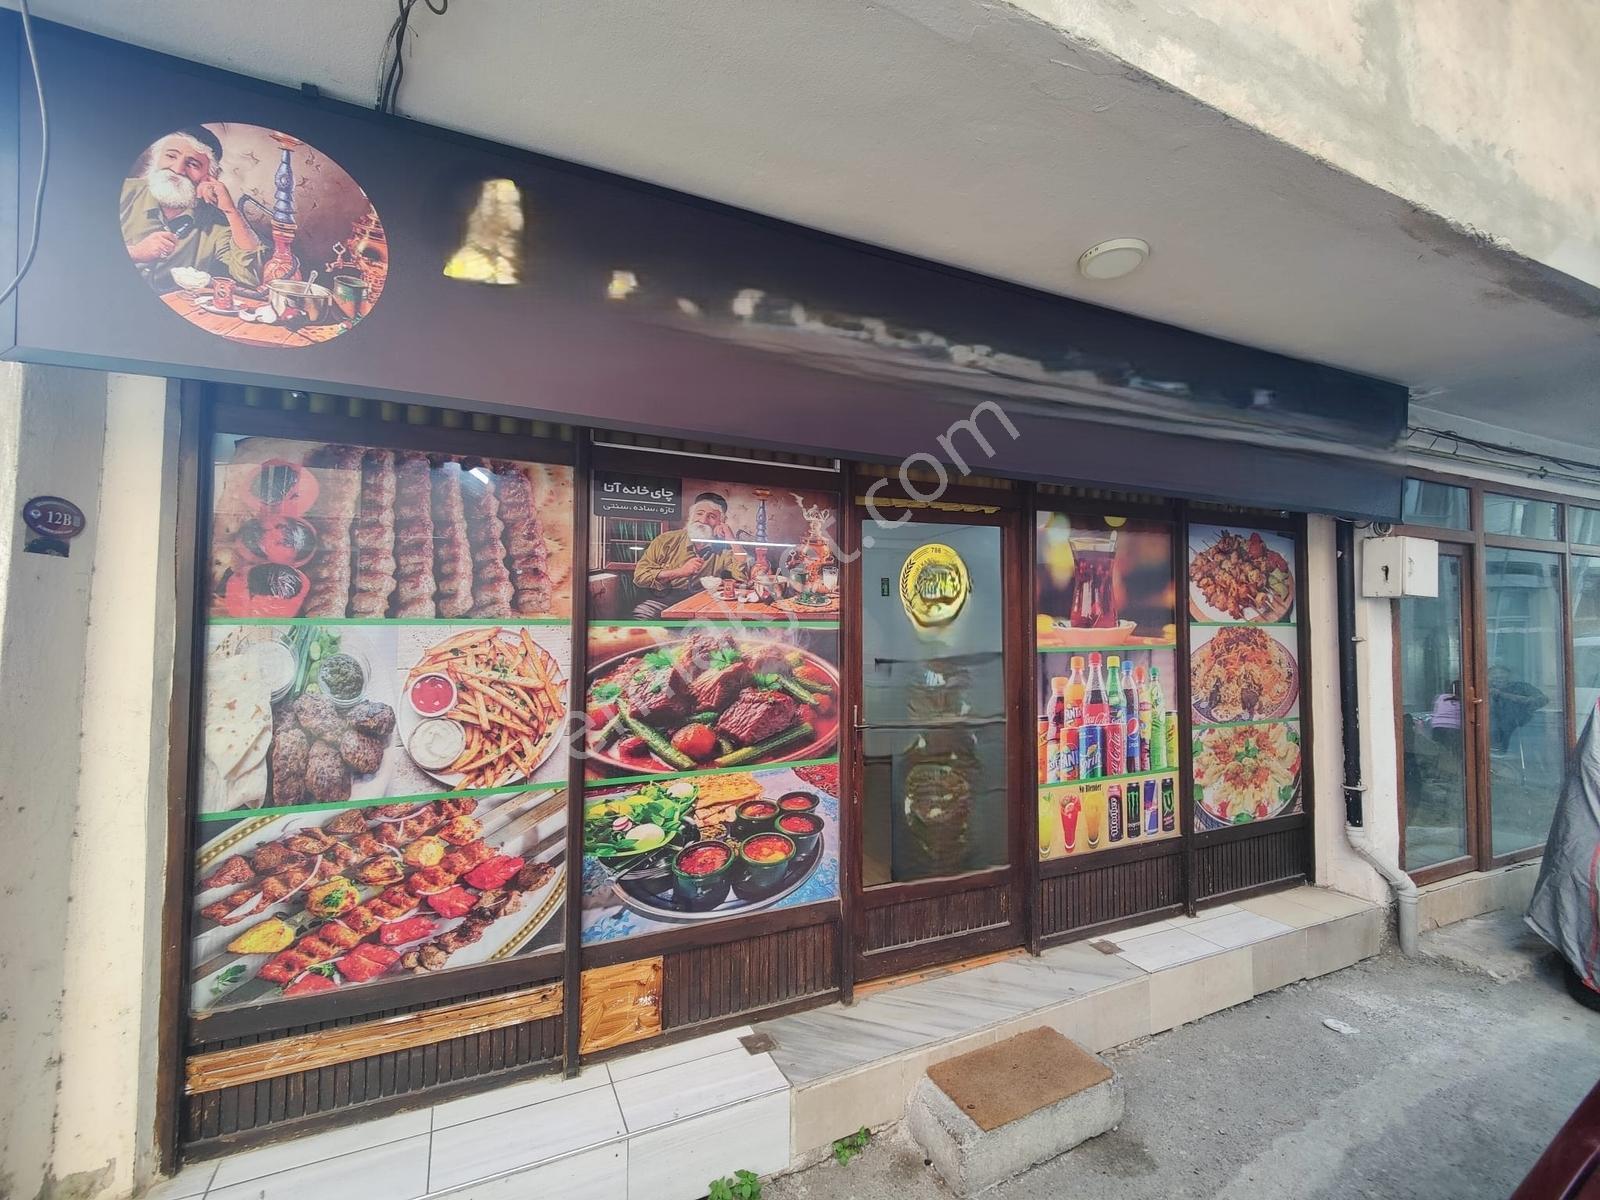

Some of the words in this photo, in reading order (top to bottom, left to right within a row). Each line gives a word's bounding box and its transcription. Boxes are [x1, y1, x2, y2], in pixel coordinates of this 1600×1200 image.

[603, 482, 622, 493] آتا
[622, 485, 650, 495] خانه
[650, 488, 674, 502] چای
[47, 511, 72, 526] 12B
